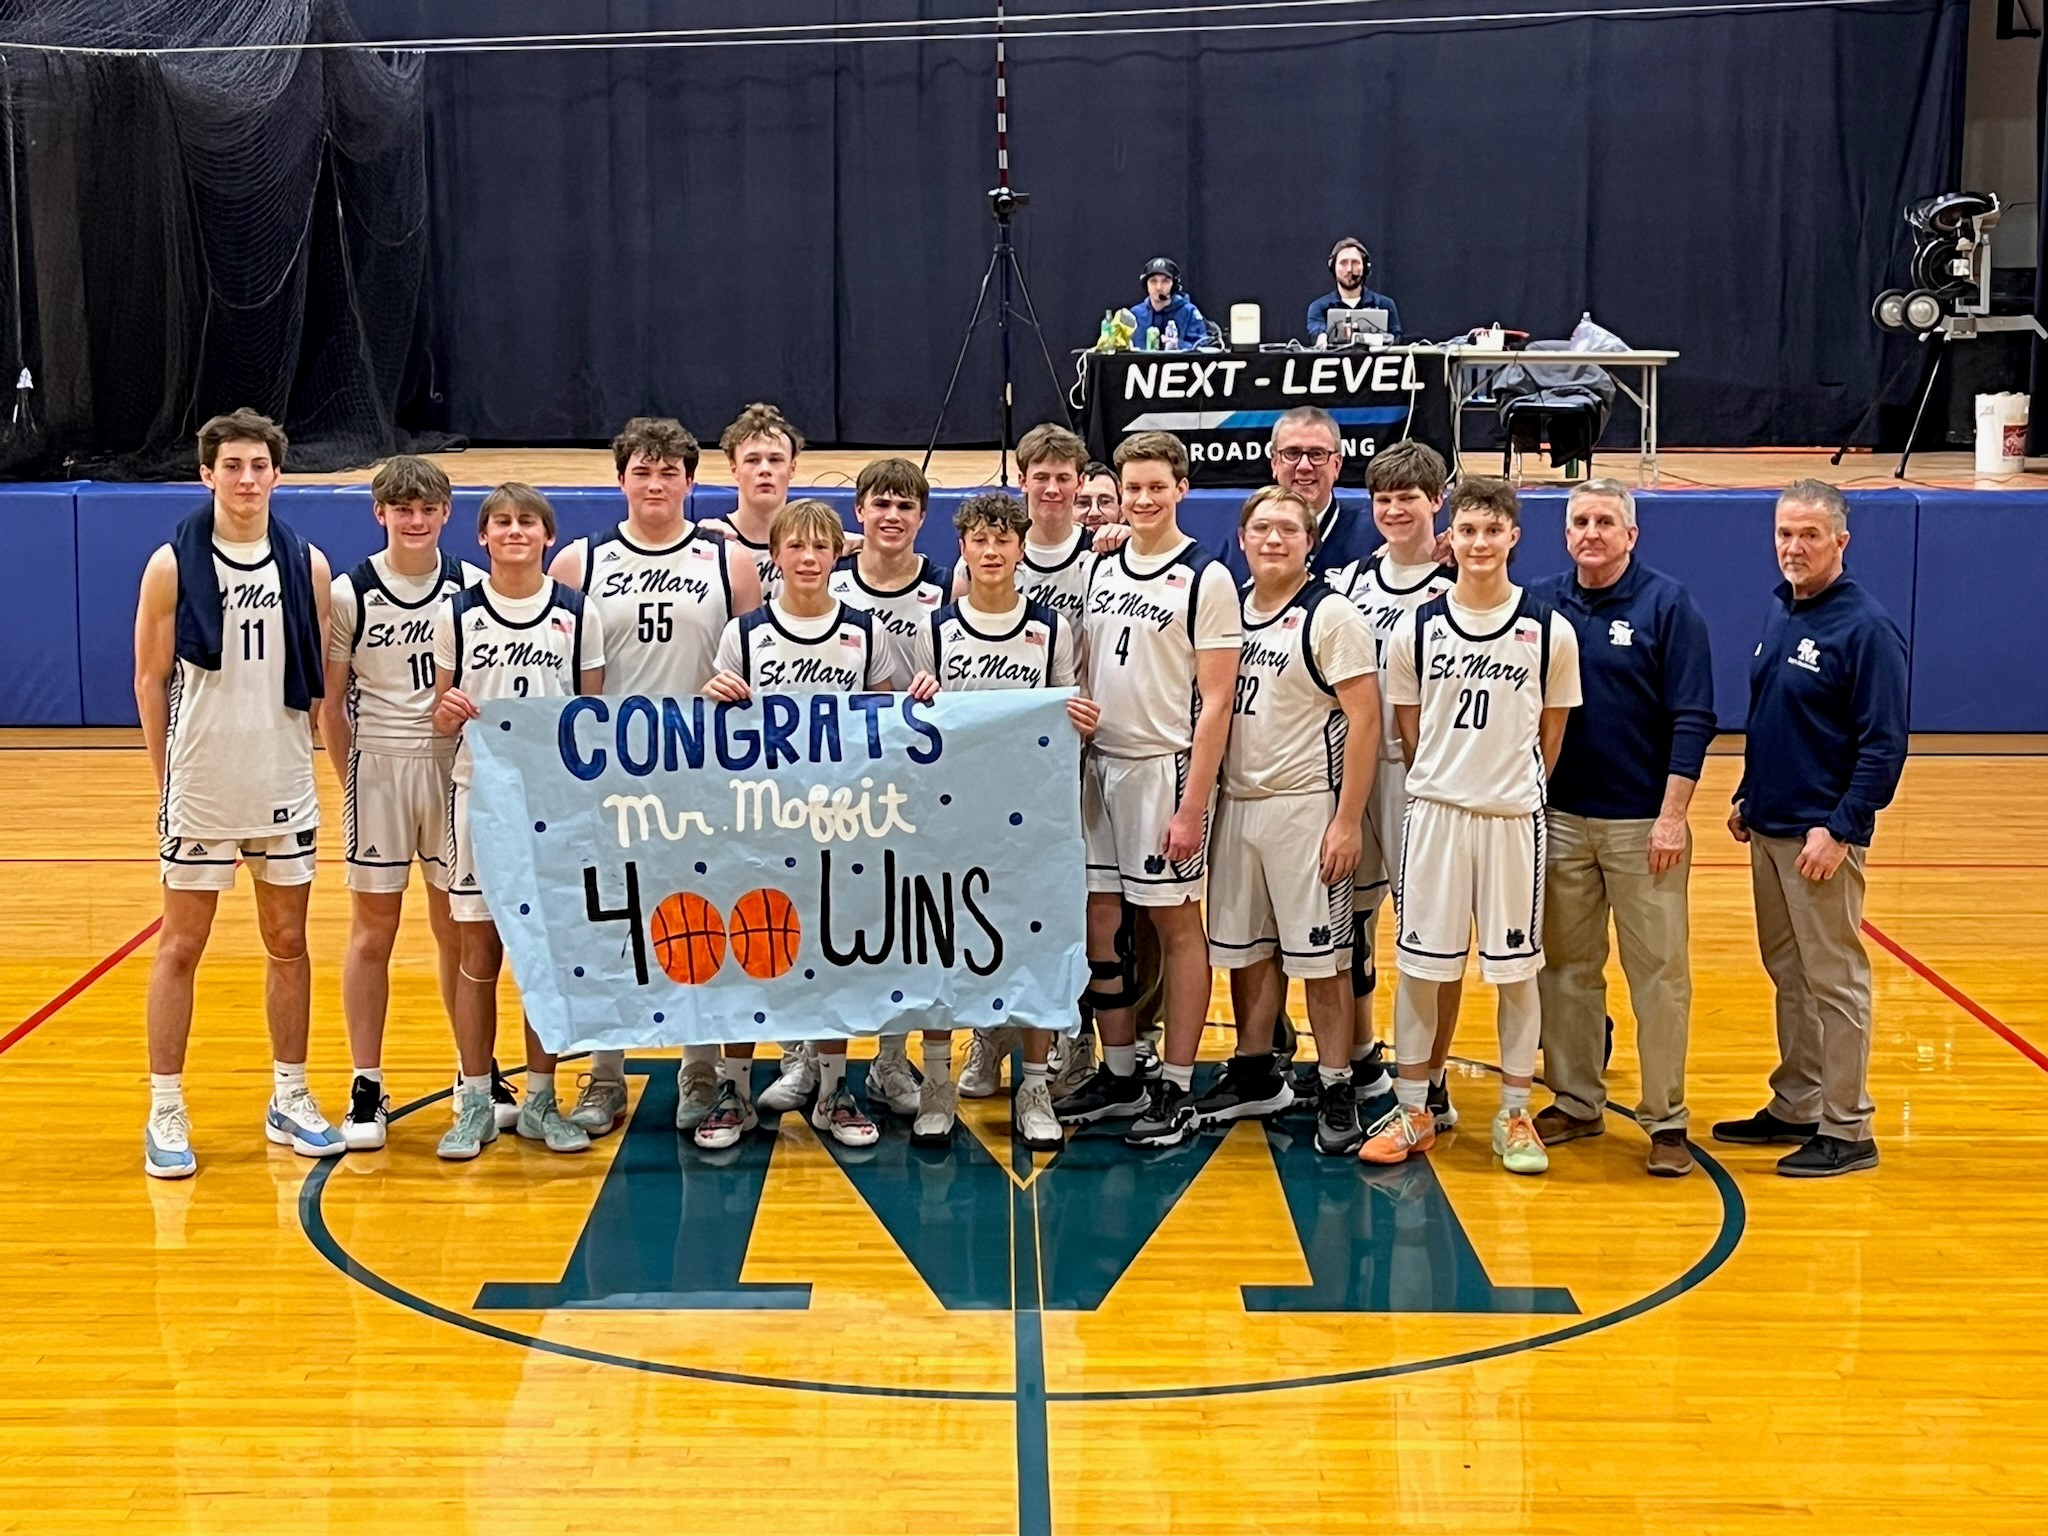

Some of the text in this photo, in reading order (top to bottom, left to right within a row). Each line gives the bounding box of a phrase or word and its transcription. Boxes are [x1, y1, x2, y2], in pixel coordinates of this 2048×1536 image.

[1124, 360, 1247, 400] NEXT
[1281, 355, 1426, 395] LEVEL
[240, 618, 264, 661] 11
[637, 602, 674, 643] 55
[1115, 626, 1131, 666] 4
[407, 651, 435, 691] 10
[1453, 688, 1490, 730] 20
[557, 694, 944, 782] CONGRATS
[602, 776, 917, 849] Mr. Moffit
